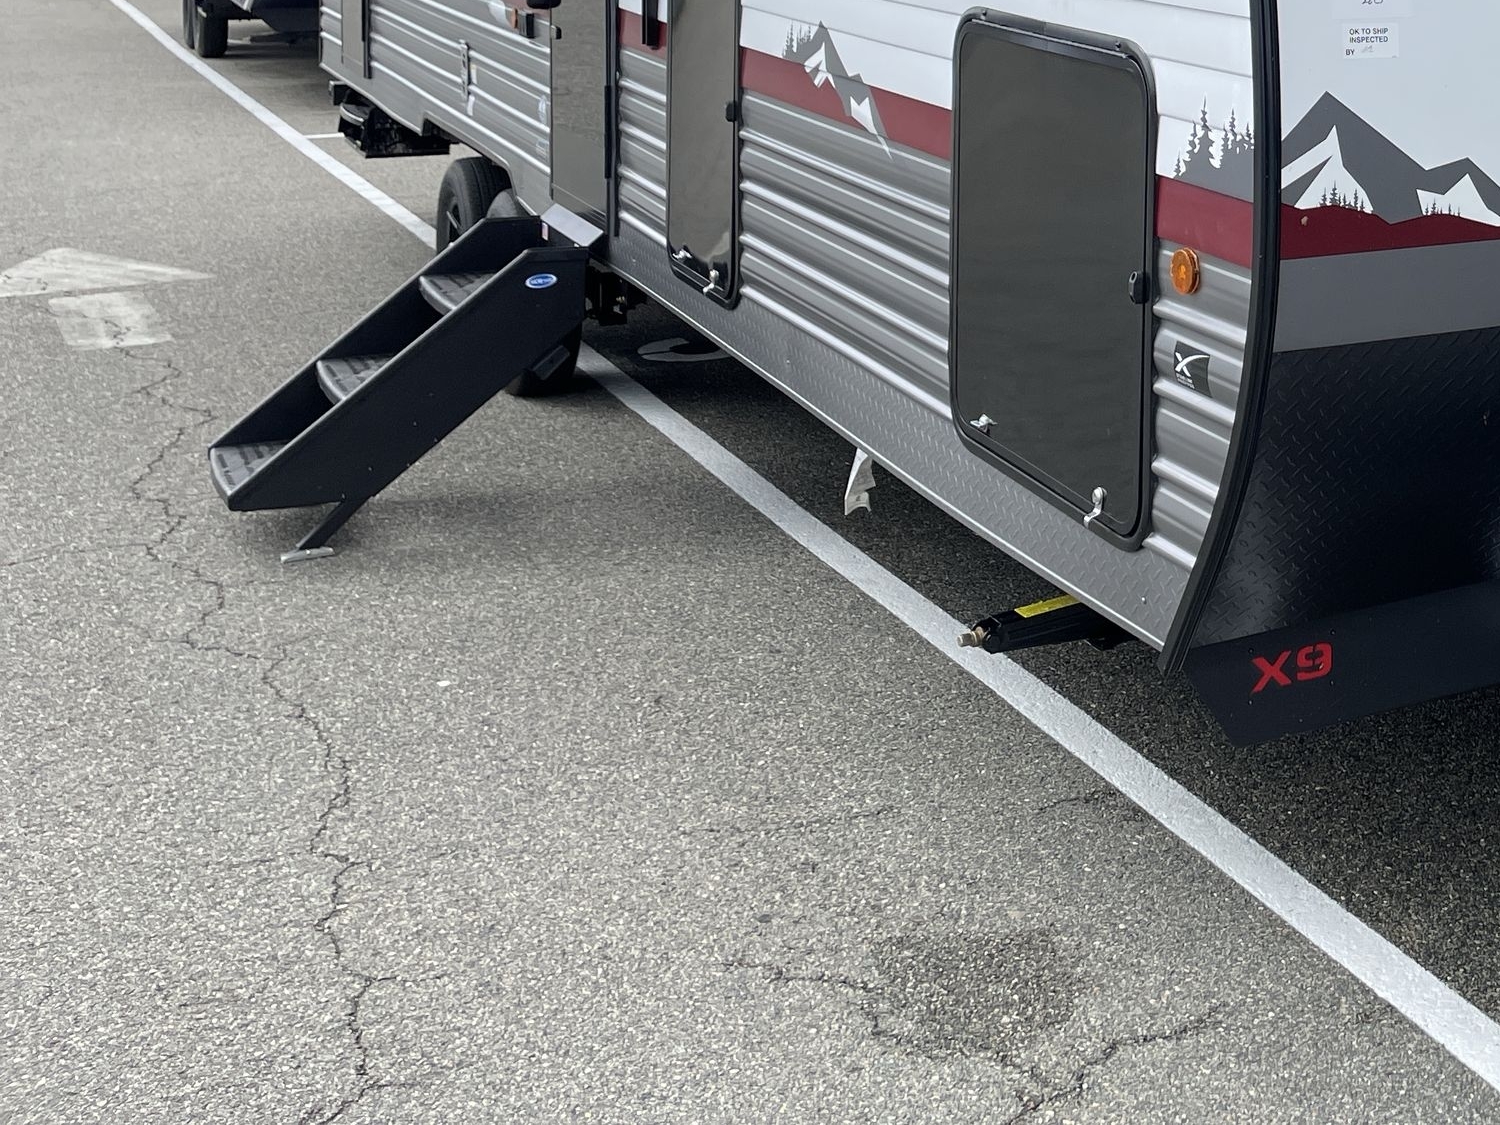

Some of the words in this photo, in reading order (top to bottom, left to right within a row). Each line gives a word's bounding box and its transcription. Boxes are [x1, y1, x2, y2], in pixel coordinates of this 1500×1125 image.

[1349, 36, 1389, 44] INSPECTED
[1345, 48, 1355, 56] BY
[1250, 640, 1333, 695] X9
